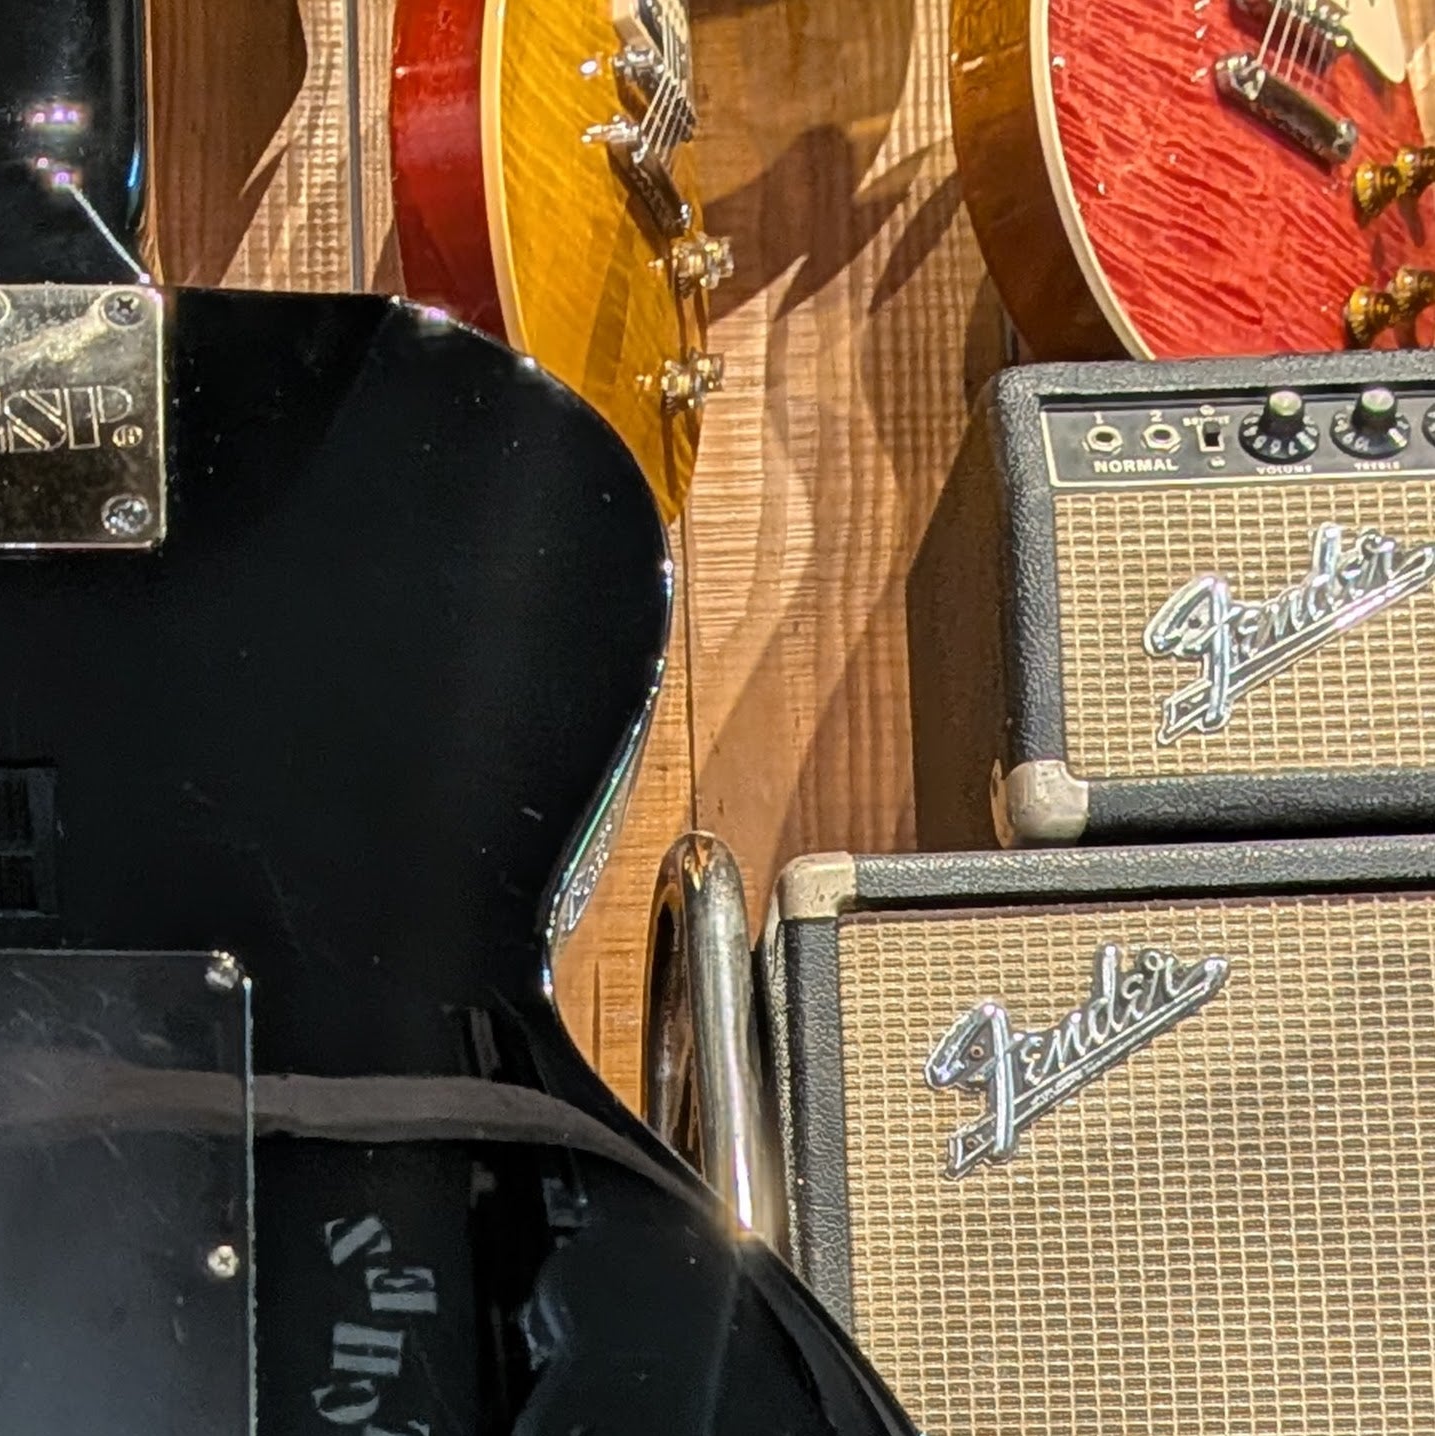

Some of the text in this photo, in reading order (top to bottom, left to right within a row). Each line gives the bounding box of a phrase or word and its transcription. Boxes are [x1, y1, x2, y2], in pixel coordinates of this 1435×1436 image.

[1093, 409, 1163, 425] 1 2
[1093, 458, 1180, 473] NORMAL
[1143, 521, 1435, 745] Fender
[924, 942, 1229, 1181] Fender
